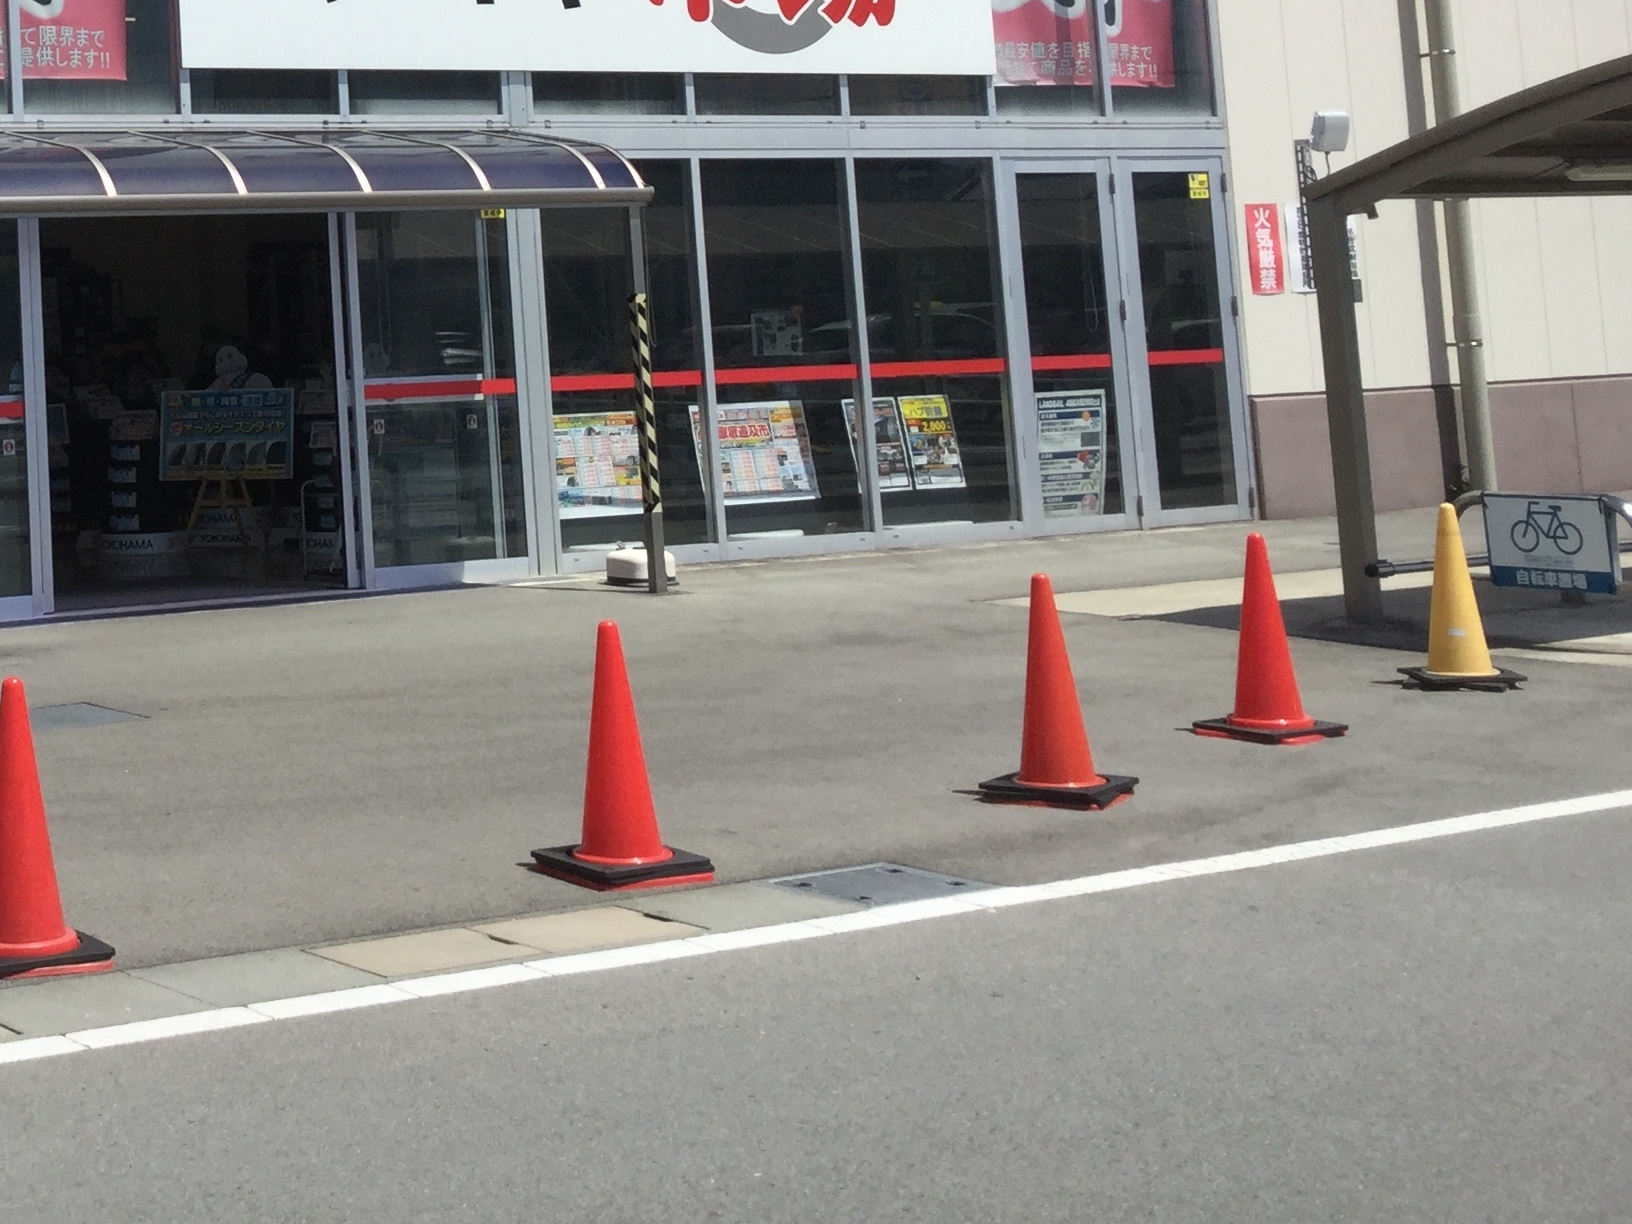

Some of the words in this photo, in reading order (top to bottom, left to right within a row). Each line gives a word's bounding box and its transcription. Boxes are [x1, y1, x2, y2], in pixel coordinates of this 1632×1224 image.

[1253, 206, 1278, 290] 火気厳禁
[1515, 569, 1588, 590] 自転車置場
